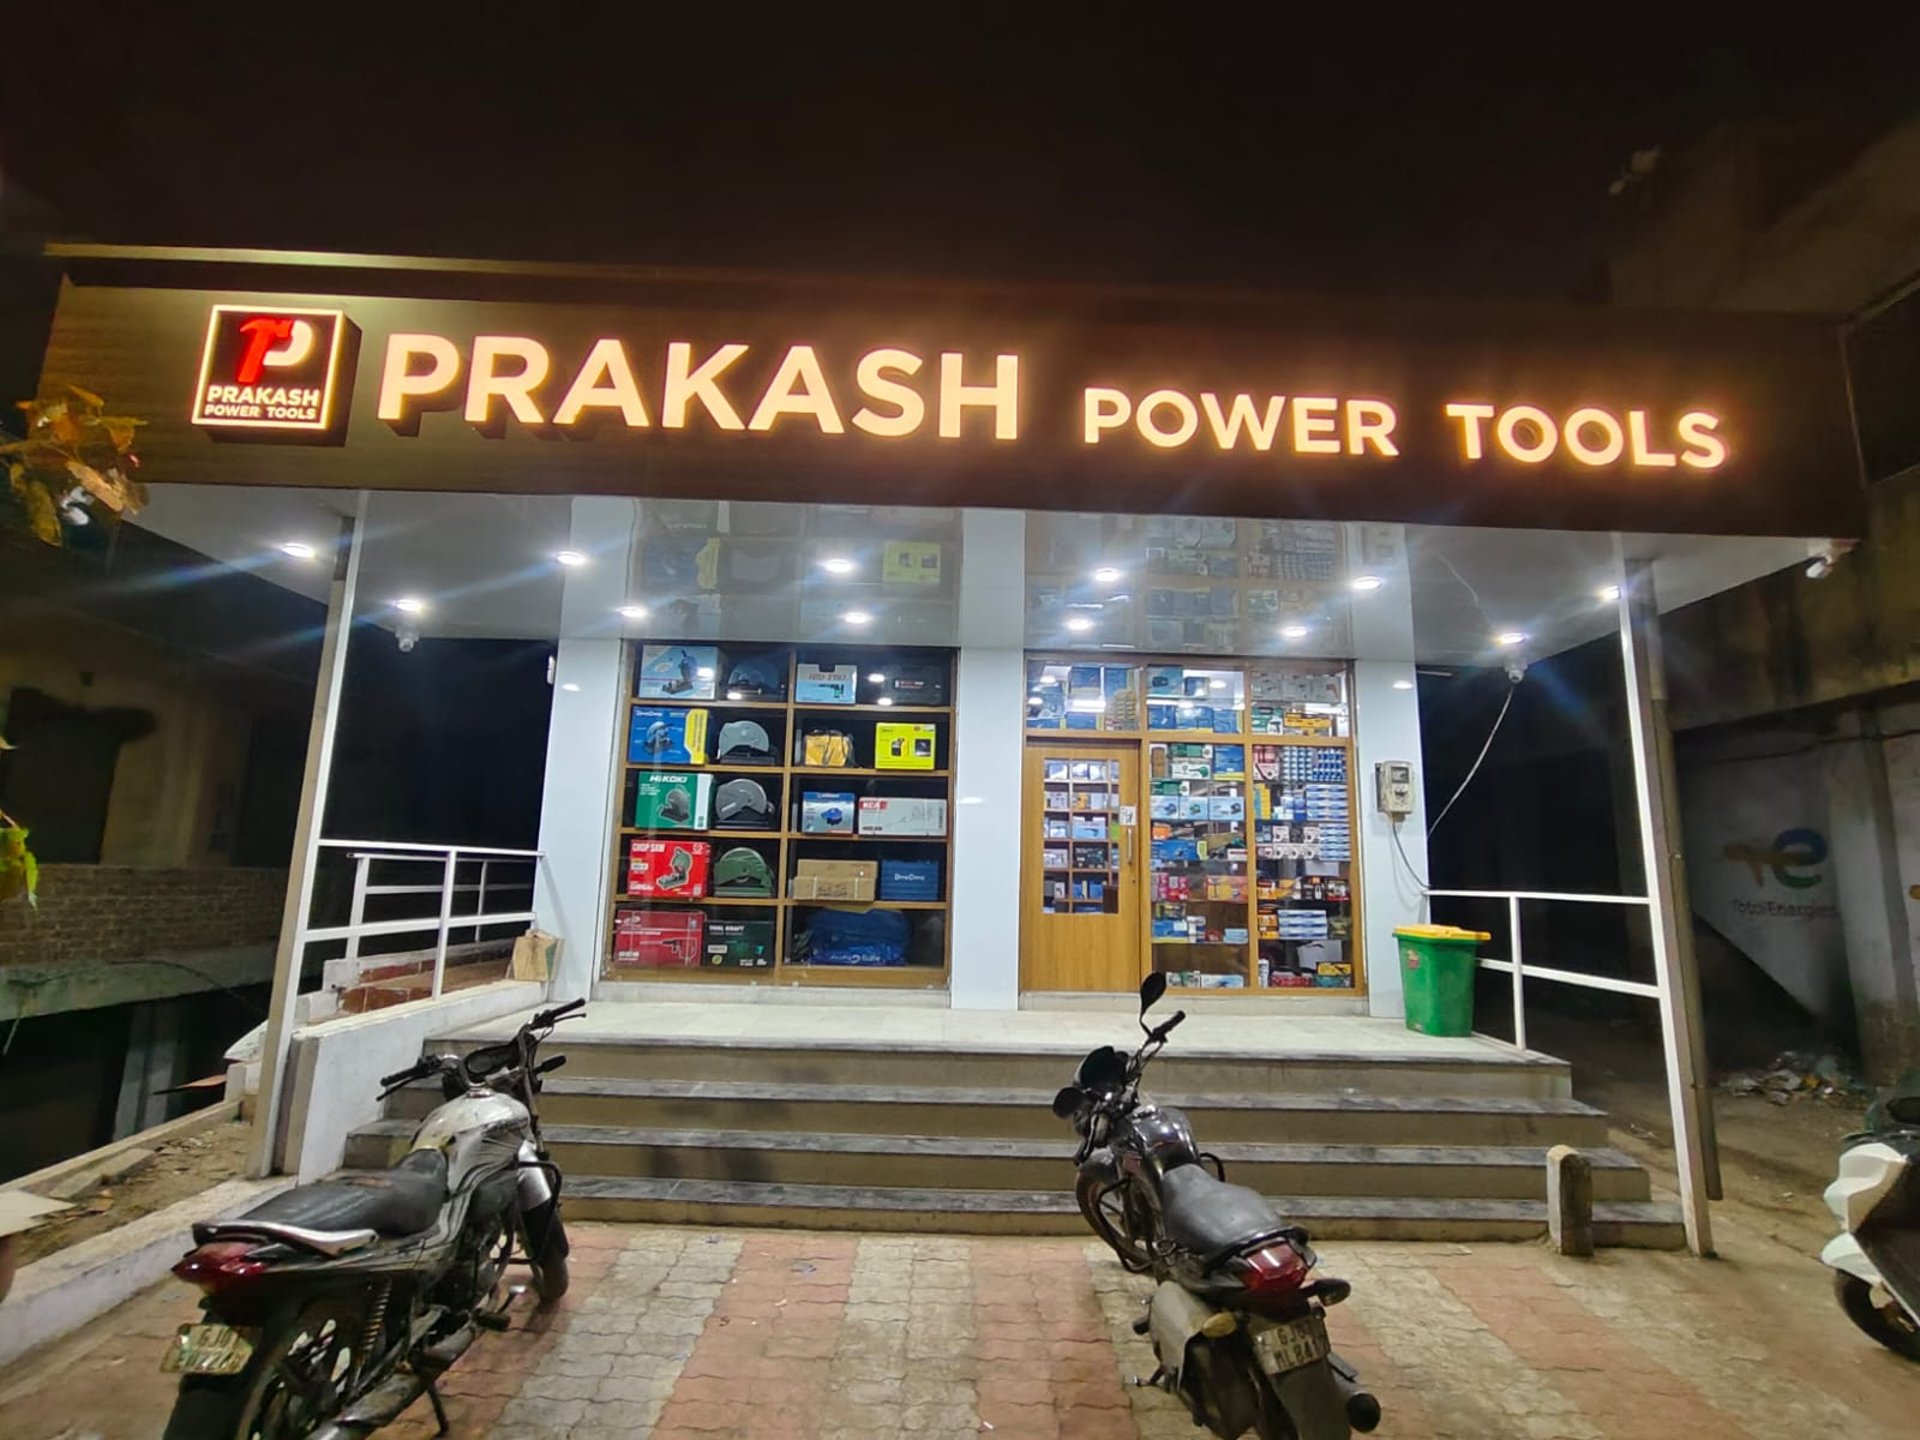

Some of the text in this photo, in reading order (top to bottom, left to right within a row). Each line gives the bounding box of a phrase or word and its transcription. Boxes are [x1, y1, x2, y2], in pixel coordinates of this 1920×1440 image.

[204, 404, 316, 419] POWER TOOLS
[206, 385, 320, 407] PRAKASH
[377, 334, 1019, 441] PRAKASH
[1084, 387, 1726, 469] POWER TOOLS
